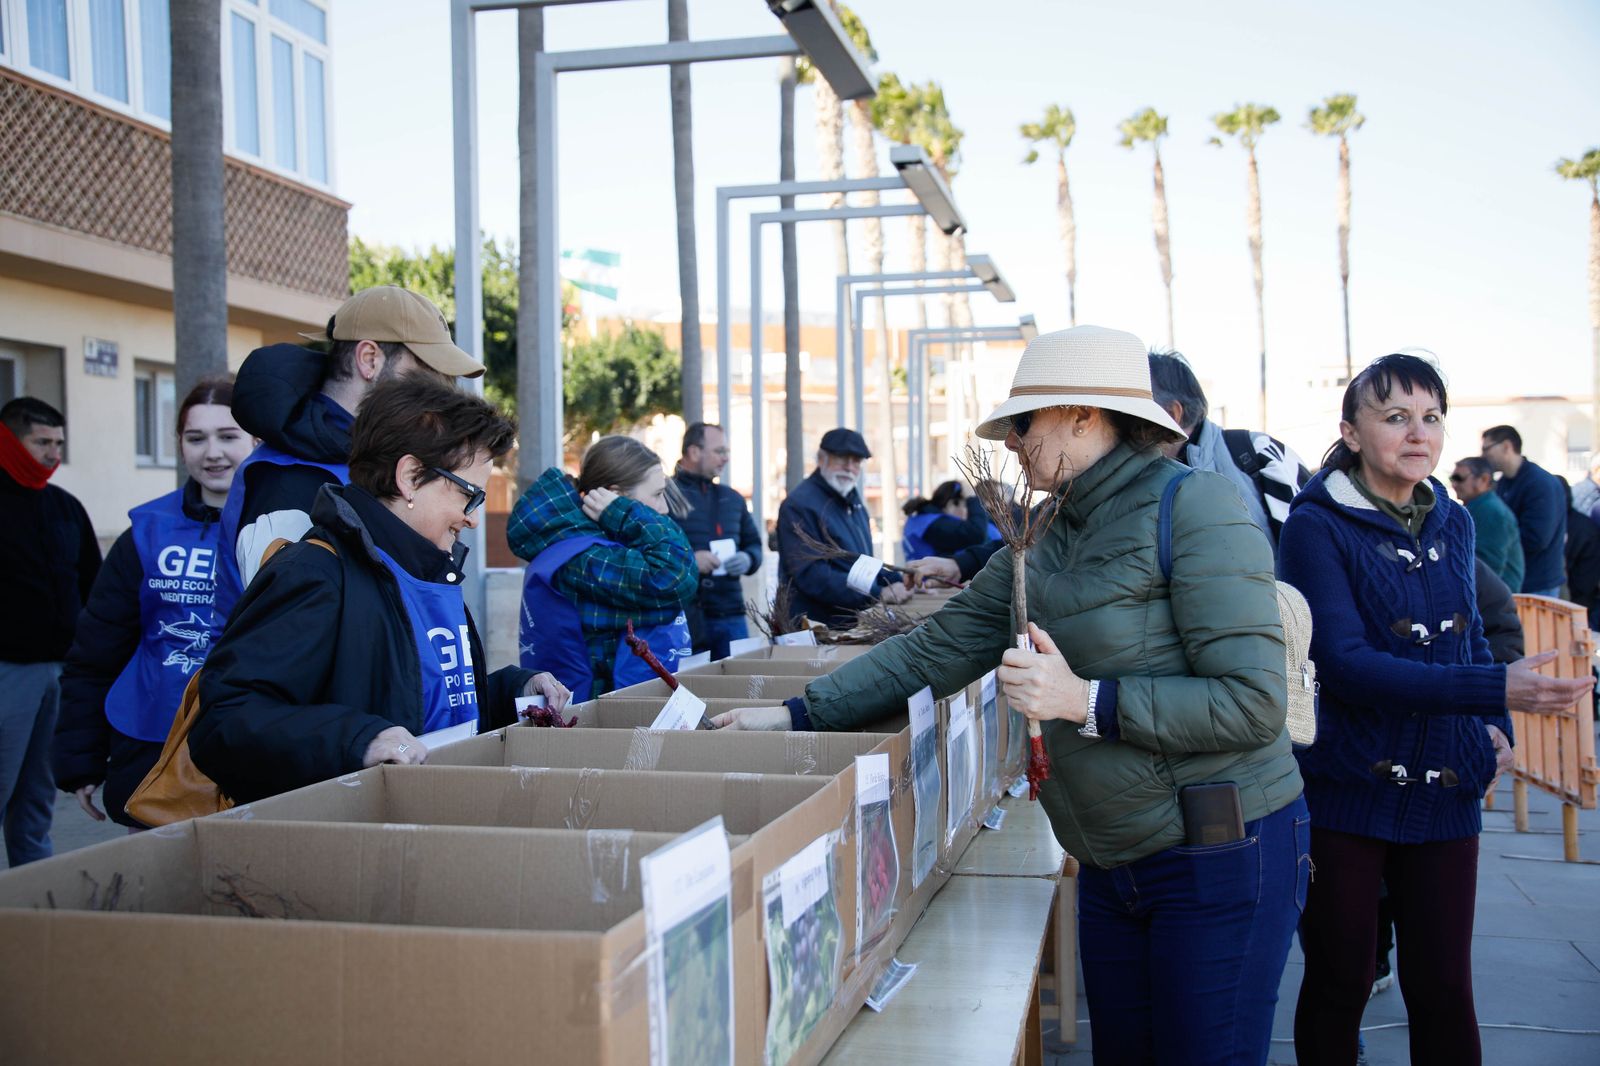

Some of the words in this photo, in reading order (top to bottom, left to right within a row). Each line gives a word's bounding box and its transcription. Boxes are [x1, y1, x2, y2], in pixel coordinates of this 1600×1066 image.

[157, 545, 217, 580] GE
[148, 578, 180, 590] GRUPO
[182, 580, 215, 591] ECOL
[464, 672, 475, 686] E
